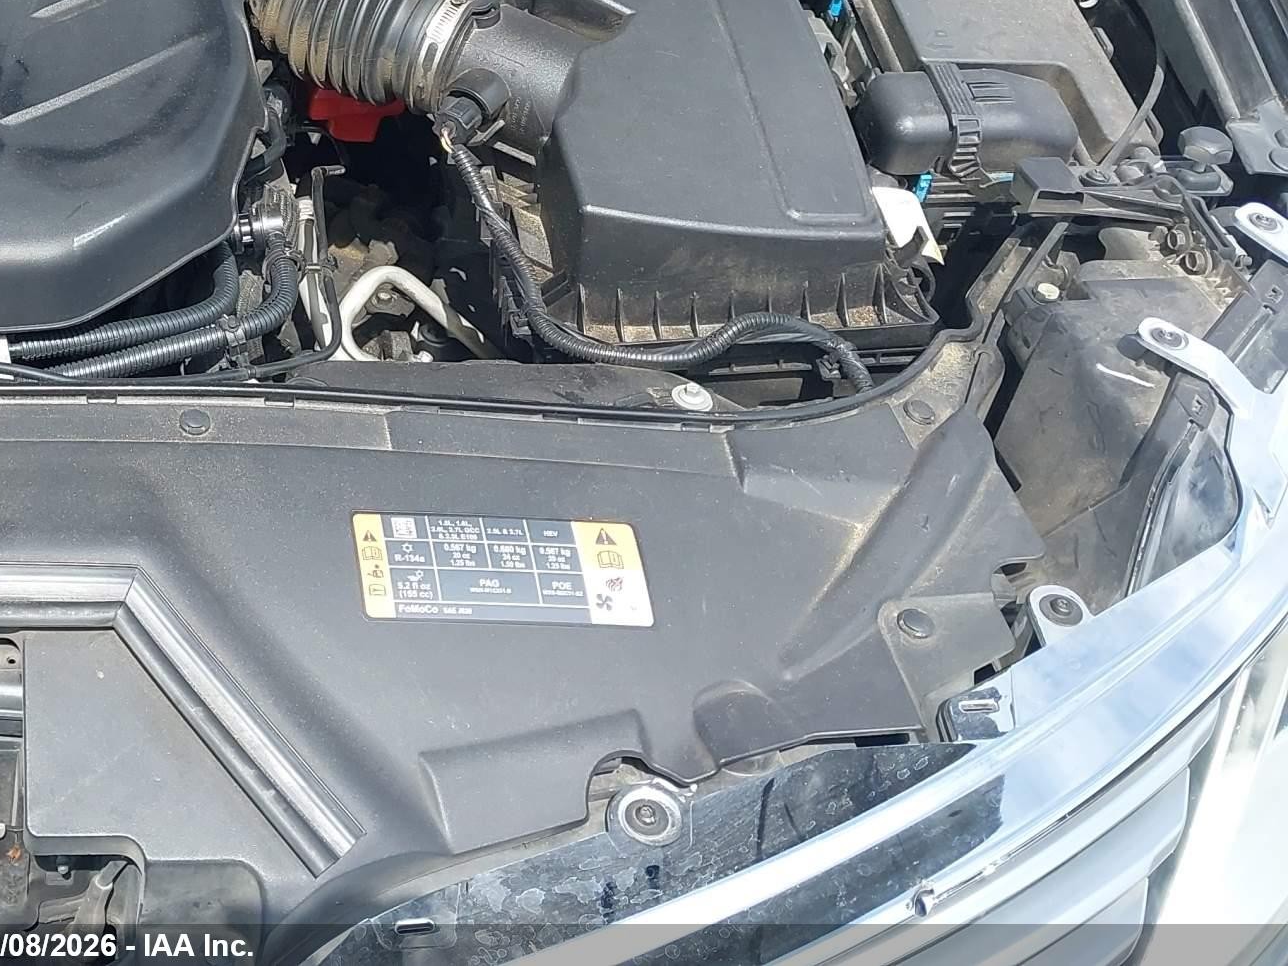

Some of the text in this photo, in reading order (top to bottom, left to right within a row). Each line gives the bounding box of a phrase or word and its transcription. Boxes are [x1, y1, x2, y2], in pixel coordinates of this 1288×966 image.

[466, 544, 477, 553] kg
[515, 546, 526, 555] kg
[560, 548, 571, 557] kg
[394, 554, 425, 562] R-134a
[397, 581, 410, 590] 5.2
[479, 578, 500, 587] PAG
[551, 581, 573, 590] POE
[419, 590, 433, 600] cc)
[398, 604, 439, 614] FoMoCo
